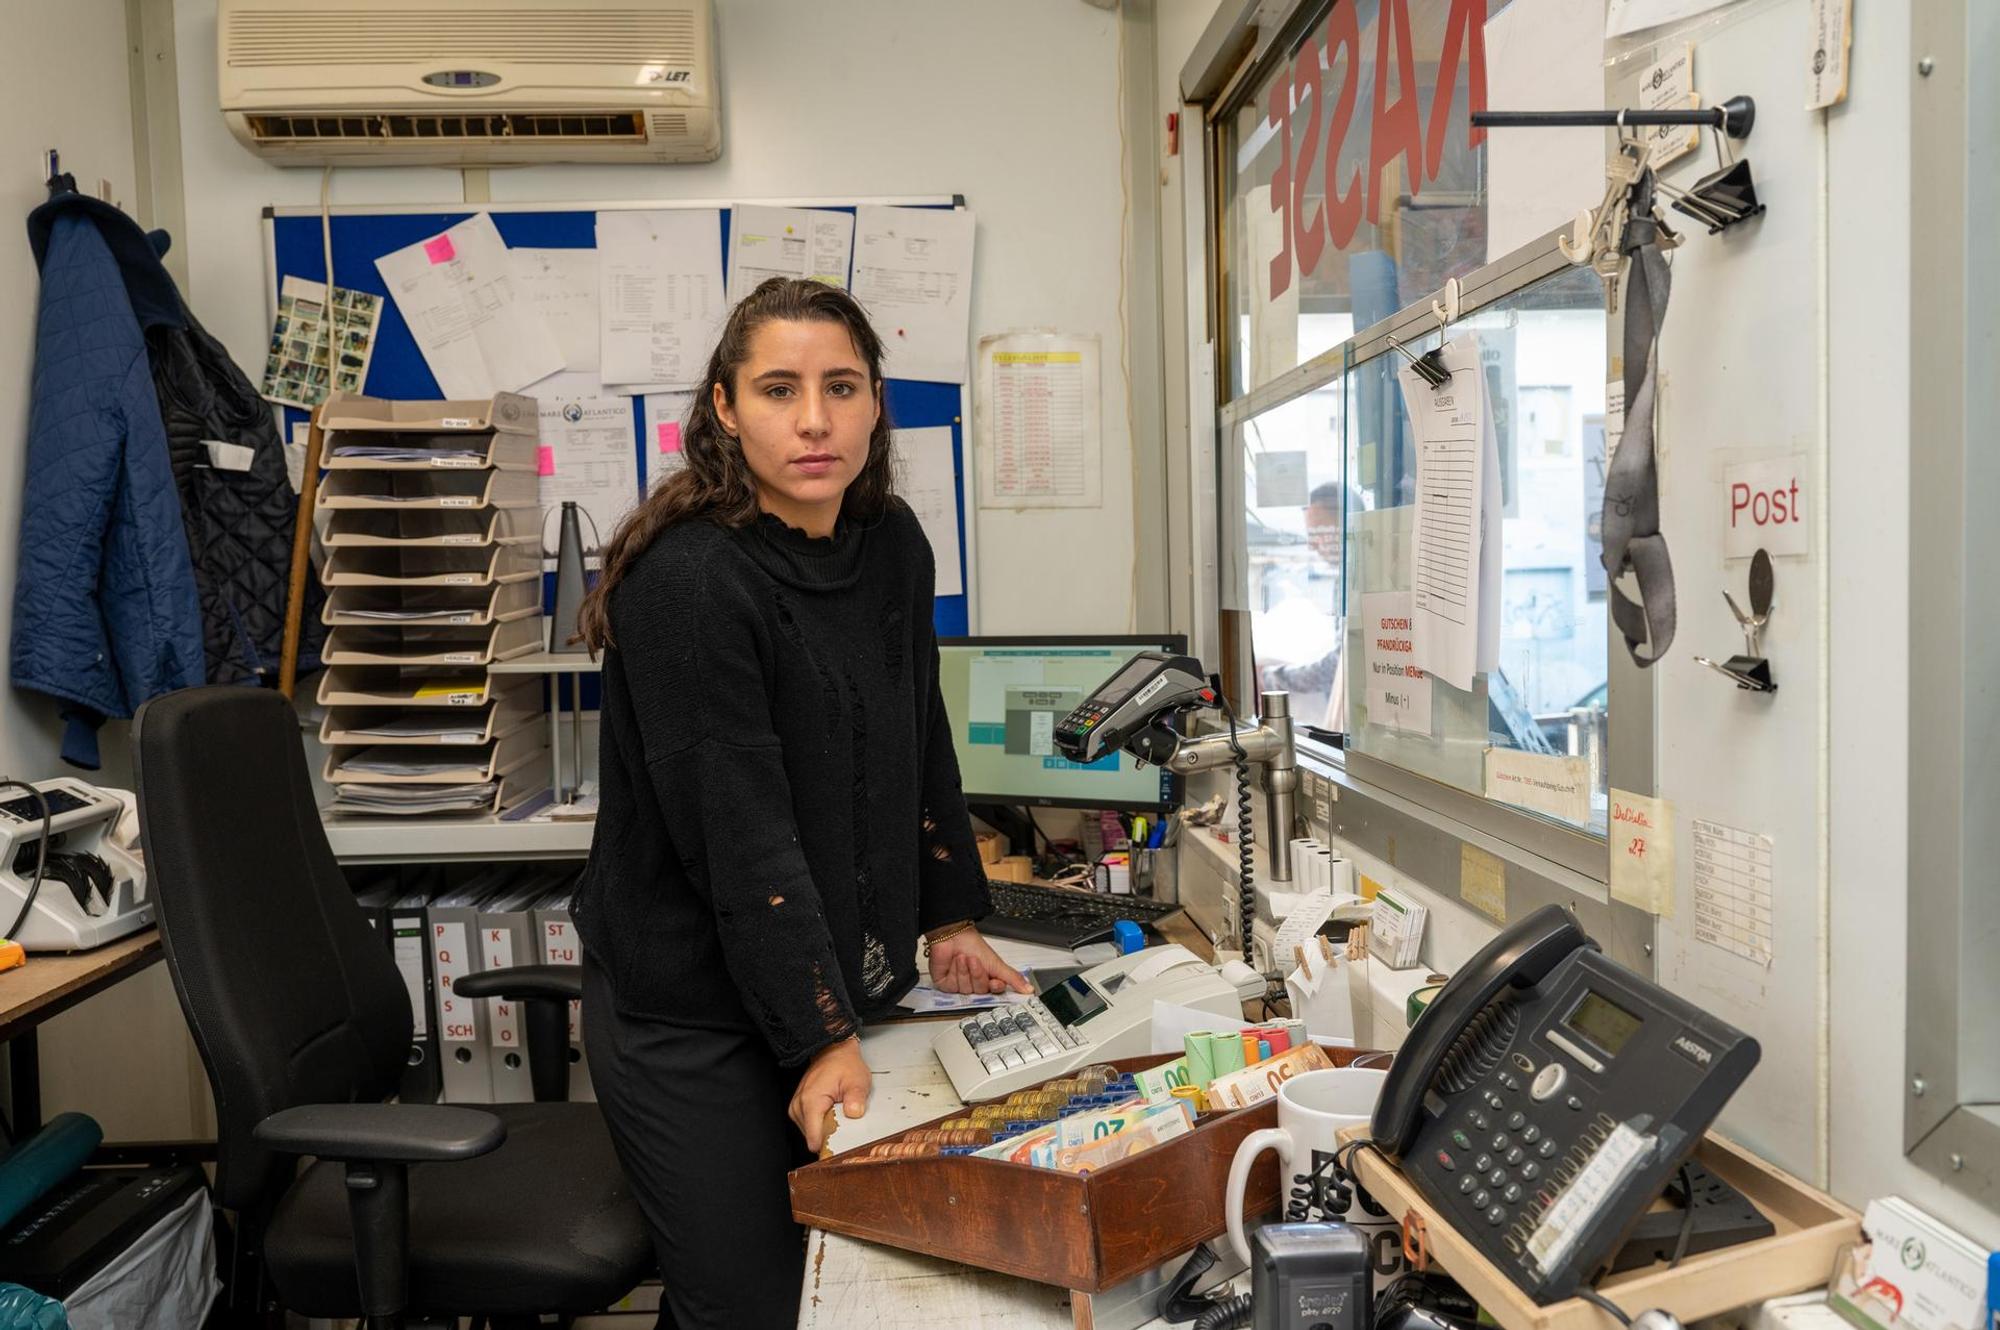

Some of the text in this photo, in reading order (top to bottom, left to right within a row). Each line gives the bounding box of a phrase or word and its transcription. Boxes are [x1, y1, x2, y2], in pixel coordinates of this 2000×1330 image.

[584, 407, 626, 416] ATLANTICO
[1731, 477, 1799, 528] Post
[1381, 618, 1408, 630] GUTSCHEIN
[1373, 662, 1381, 674] Nur
[1385, 692, 1399, 705] Minus
[1628, 838, 1645, 858] 27
[436, 926, 445, 937] P
[548, 925, 564, 936] ST
[491, 931, 500, 942] K
[439, 951, 452, 964] Q
[551, 949, 573, 961] T-U
[494, 956, 501, 967] L
[442, 976, 450, 987] R
[444, 1001, 452, 1012] S
[499, 1006, 509, 1016] N
[447, 1025, 473, 1037] SCH
[501, 1030, 512, 1041] O
